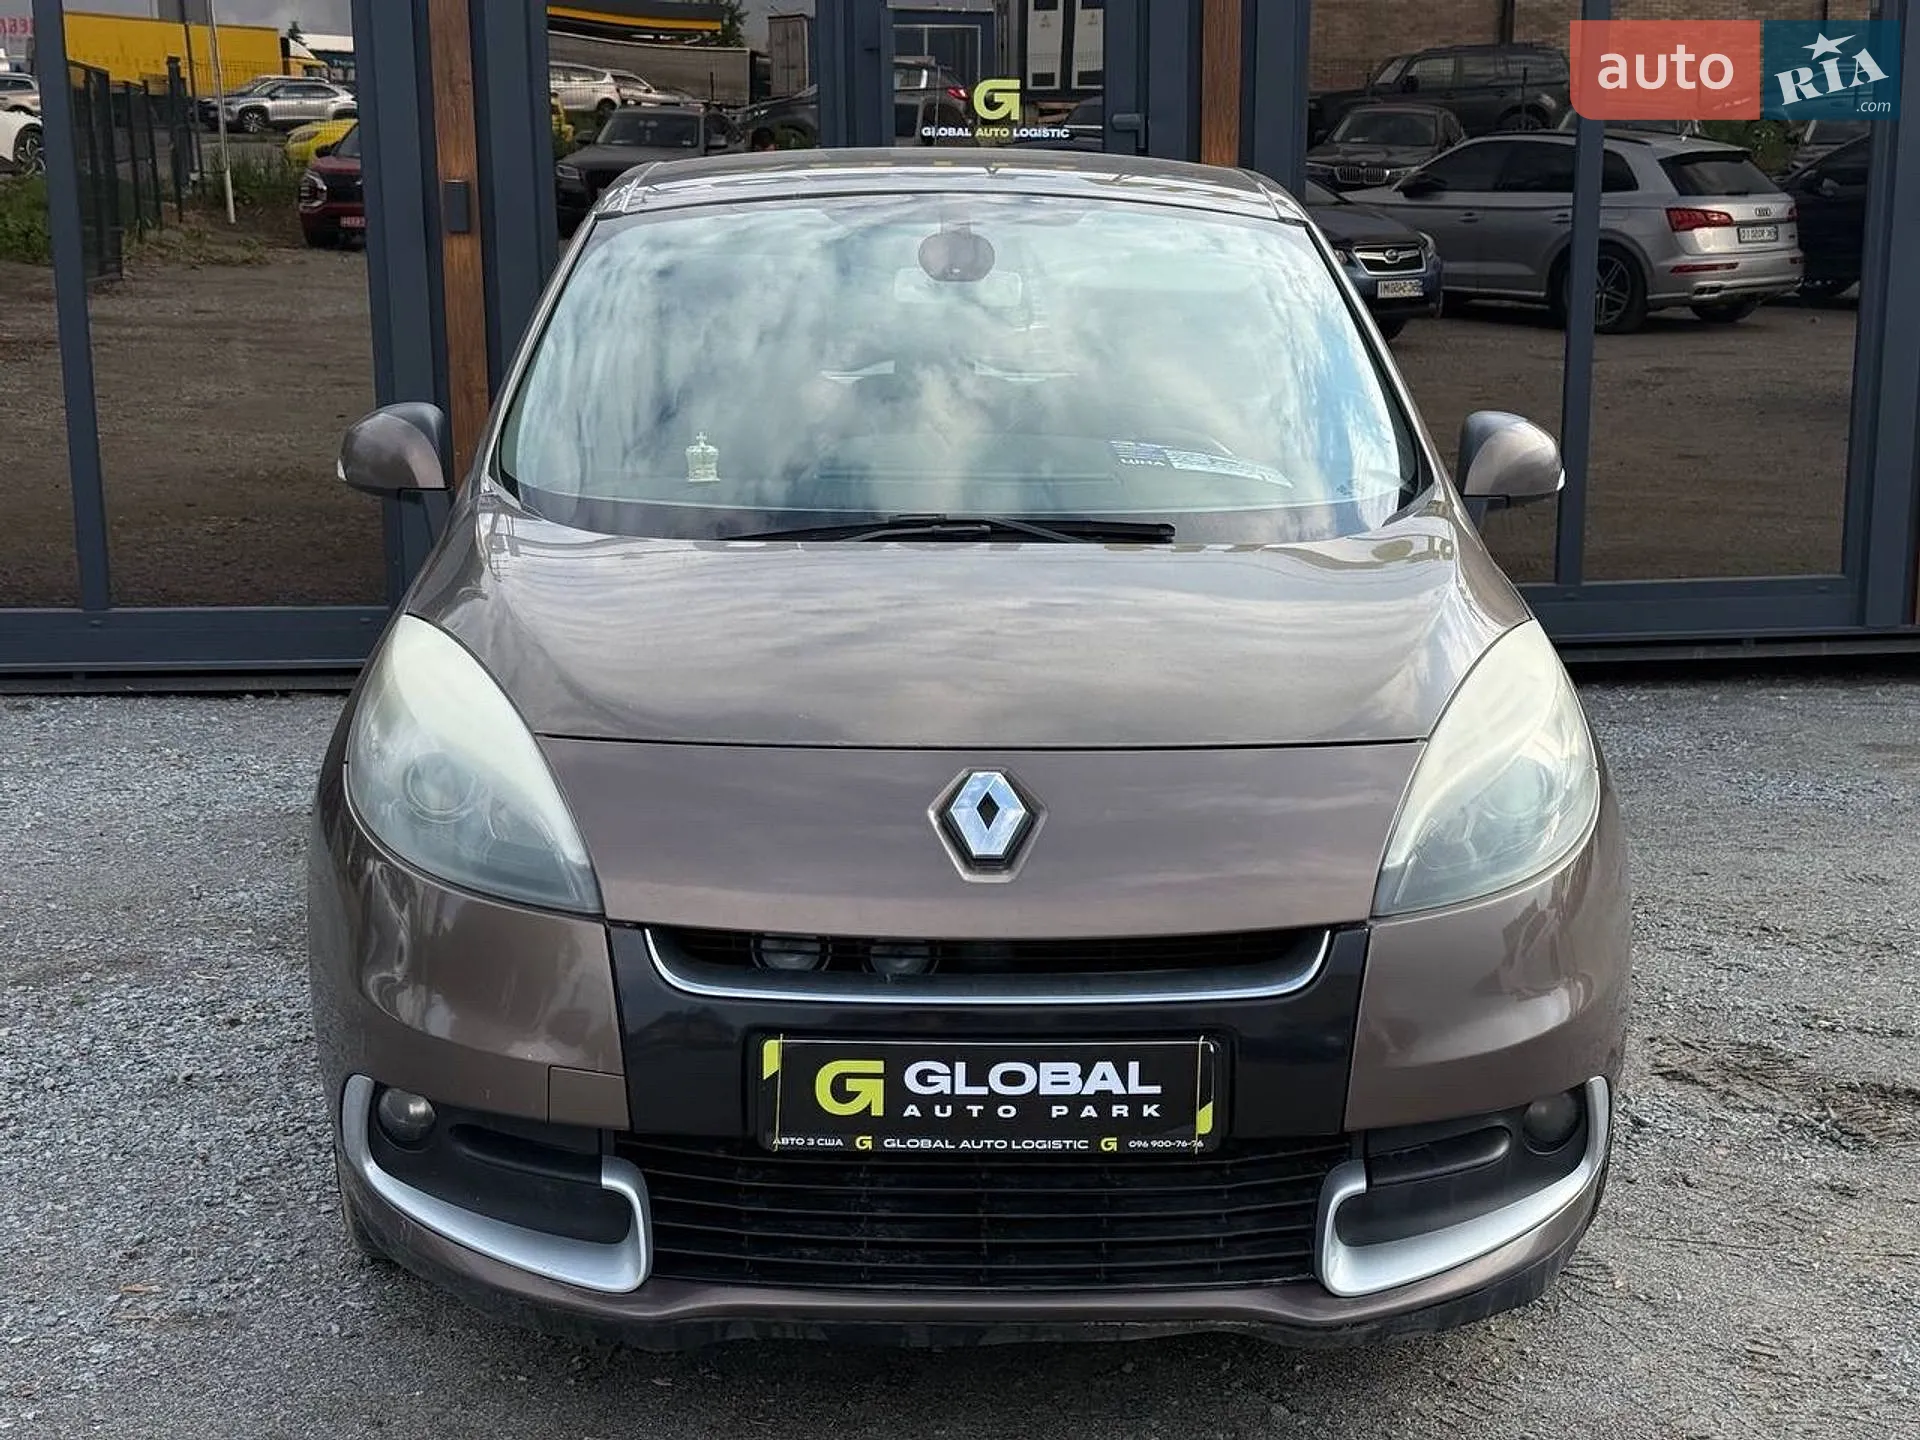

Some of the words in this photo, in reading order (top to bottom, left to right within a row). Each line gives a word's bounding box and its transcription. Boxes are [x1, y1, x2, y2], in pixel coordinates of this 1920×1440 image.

[921, 126, 972, 138] GLOBAL
[974, 127, 1010, 138] AUTO
[1012, 128, 1070, 139] LOGISTIC
[903, 1060, 1162, 1096] GLOBAL
[902, 1104, 1018, 1119] AUTO
[1050, 1104, 1162, 1119] PARK
[816, 1137, 844, 1147] США
[883, 1138, 955, 1149] GLOBAL
[958, 1139, 1008, 1149] AUTO
[1011, 1140, 1089, 1150] LOGISTIC
[1127, 1140, 1149, 1149] 096
